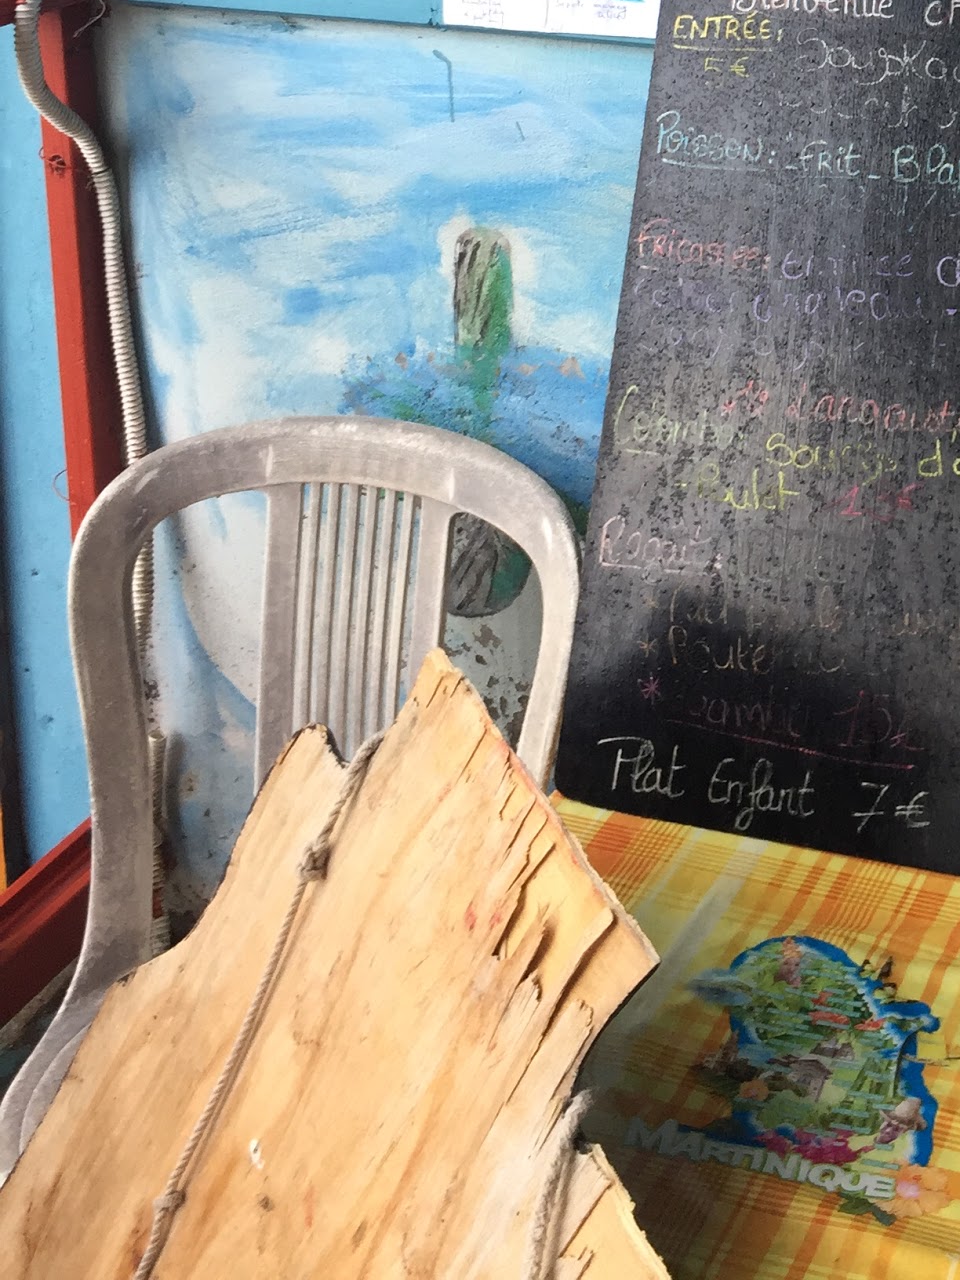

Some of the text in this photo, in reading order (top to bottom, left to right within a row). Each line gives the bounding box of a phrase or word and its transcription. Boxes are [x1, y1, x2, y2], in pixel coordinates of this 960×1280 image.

[597, 736, 686, 797] Plat
[709, 758, 815, 831] Enfant
[624, 1118, 897, 1200] MARTINIQUE
